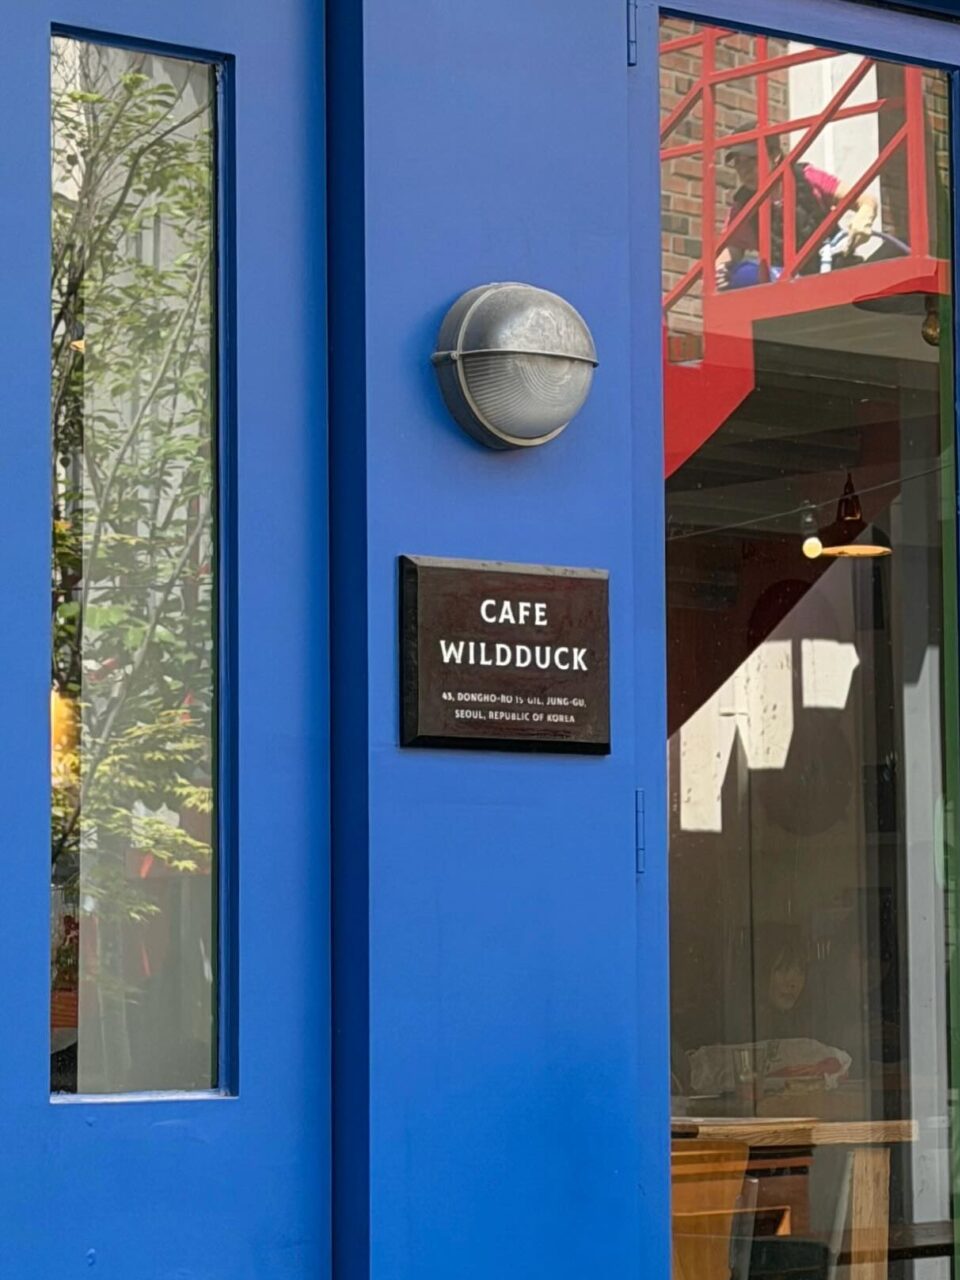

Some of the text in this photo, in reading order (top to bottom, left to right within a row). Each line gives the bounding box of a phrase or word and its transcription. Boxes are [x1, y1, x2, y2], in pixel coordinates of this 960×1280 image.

[480, 599, 548, 626] CAFE
[439, 639, 588, 672] WILDDUCK
[454, 709, 575, 723] SEOUL, REPUBLIC OF KOREA
